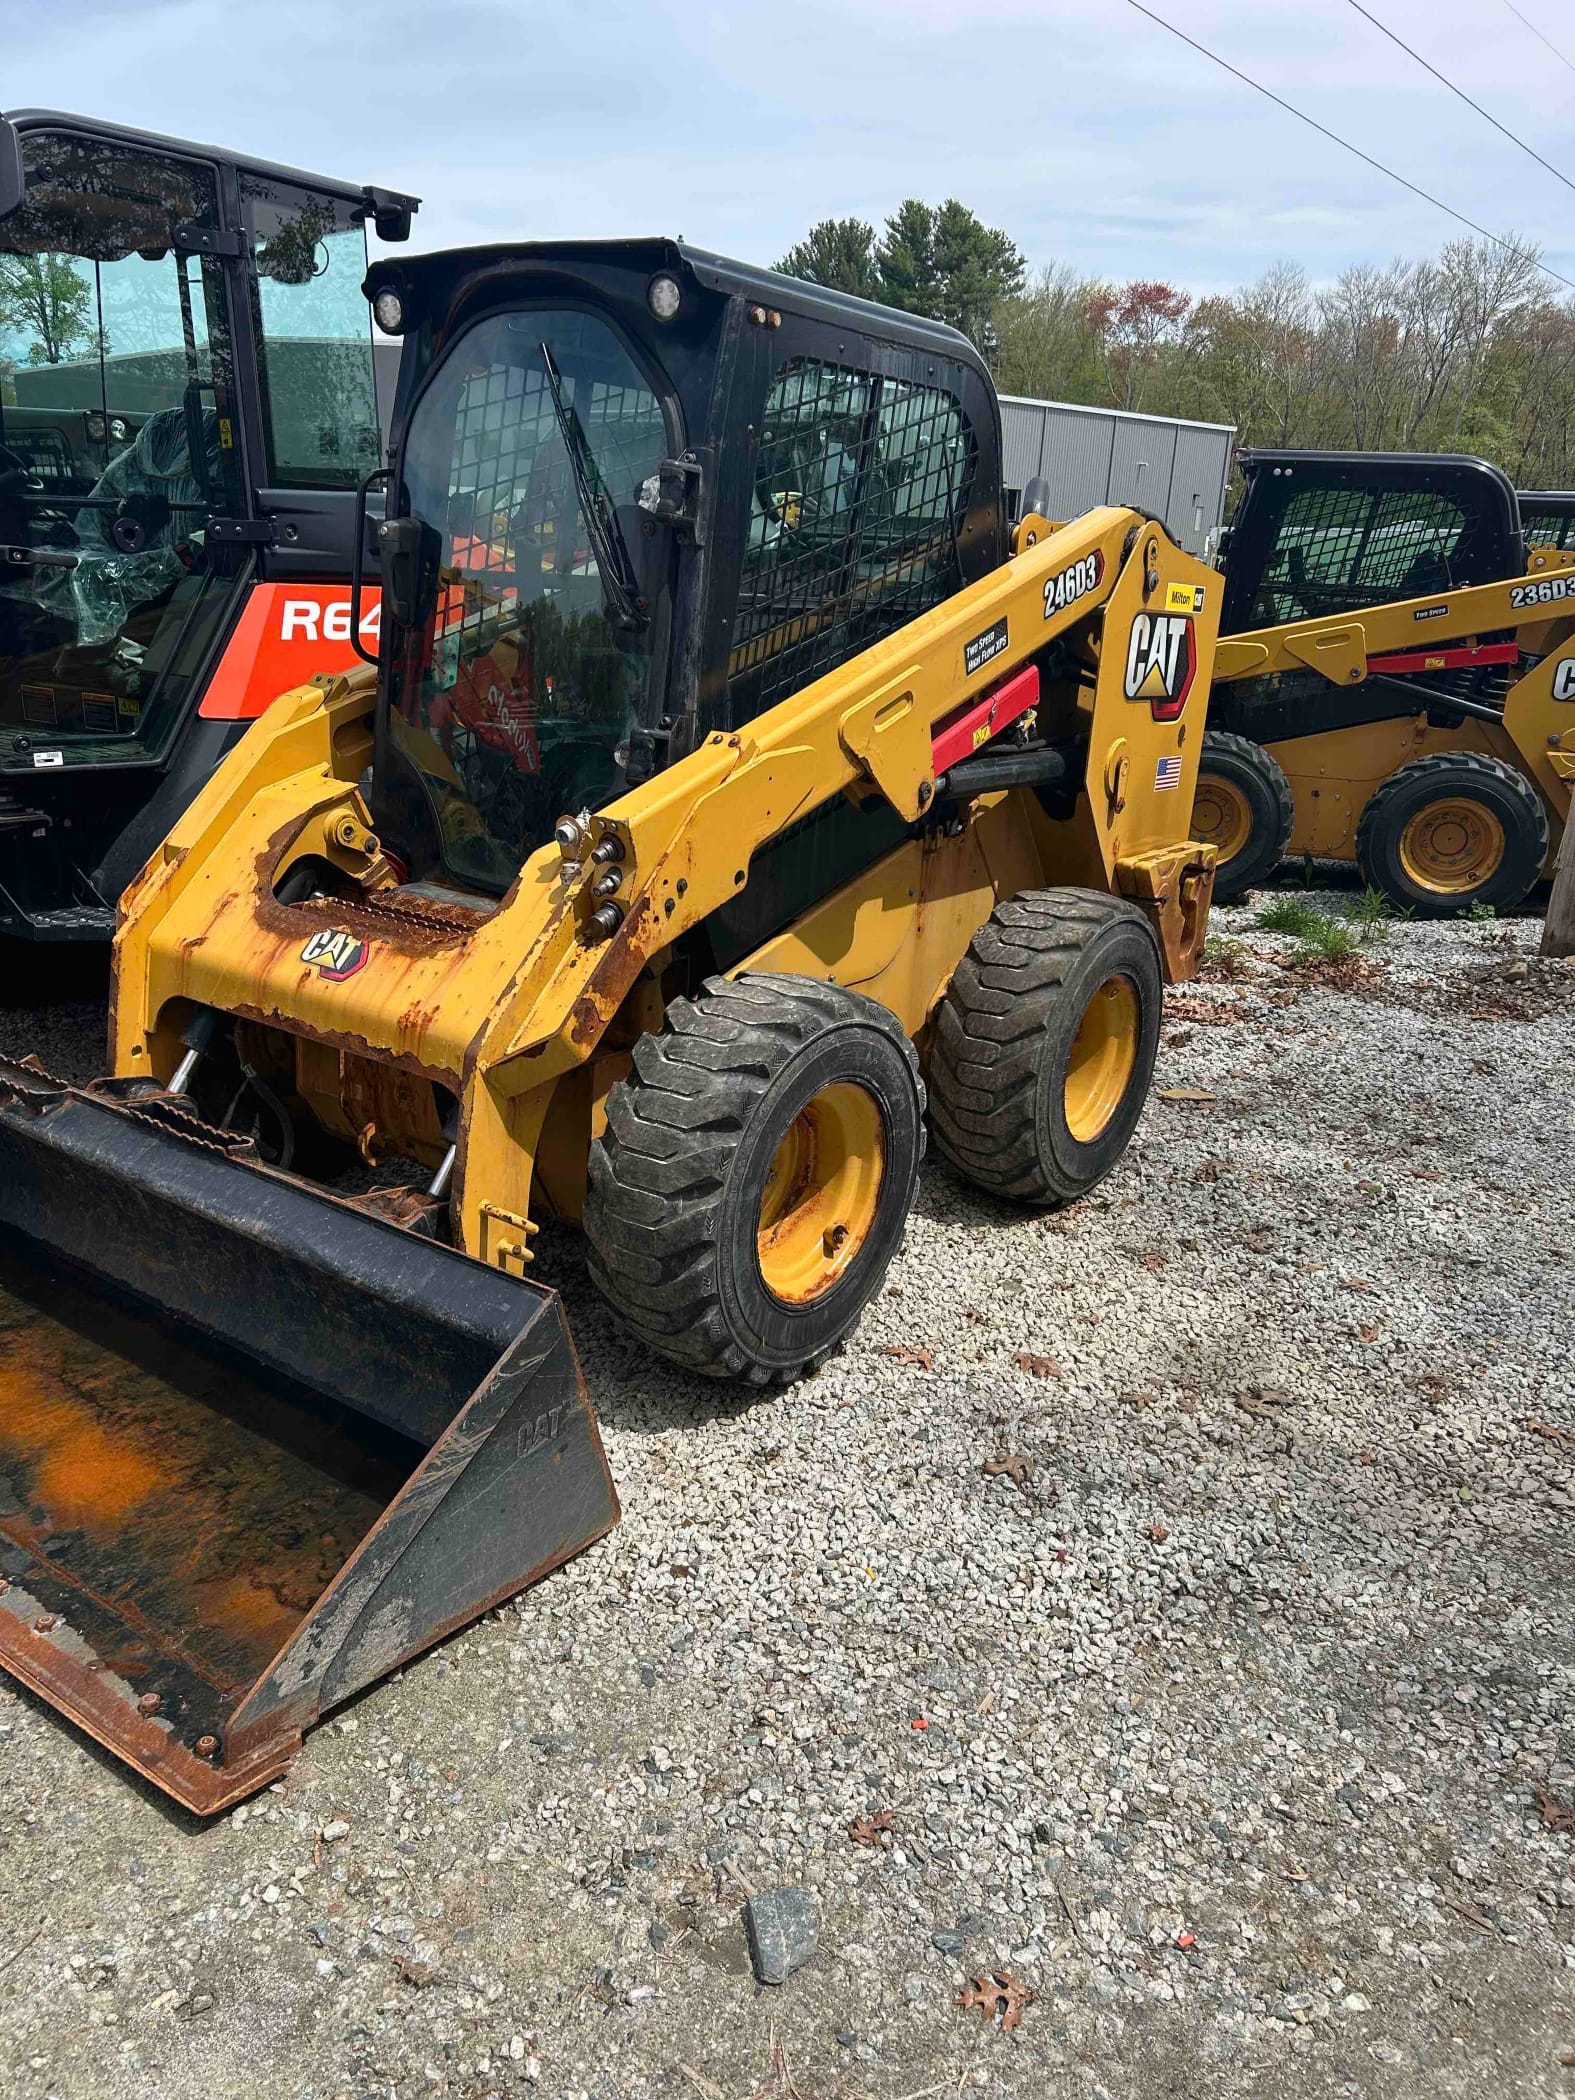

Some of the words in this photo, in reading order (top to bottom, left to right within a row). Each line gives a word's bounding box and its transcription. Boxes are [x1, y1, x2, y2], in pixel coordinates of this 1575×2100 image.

[1043, 554, 1097, 618] 246D3
[1170, 590, 1191, 606] Milton
[1125, 614, 1187, 697] CAT
[301, 928, 362, 970] CAT
[517, 1404, 563, 1458] CAT
